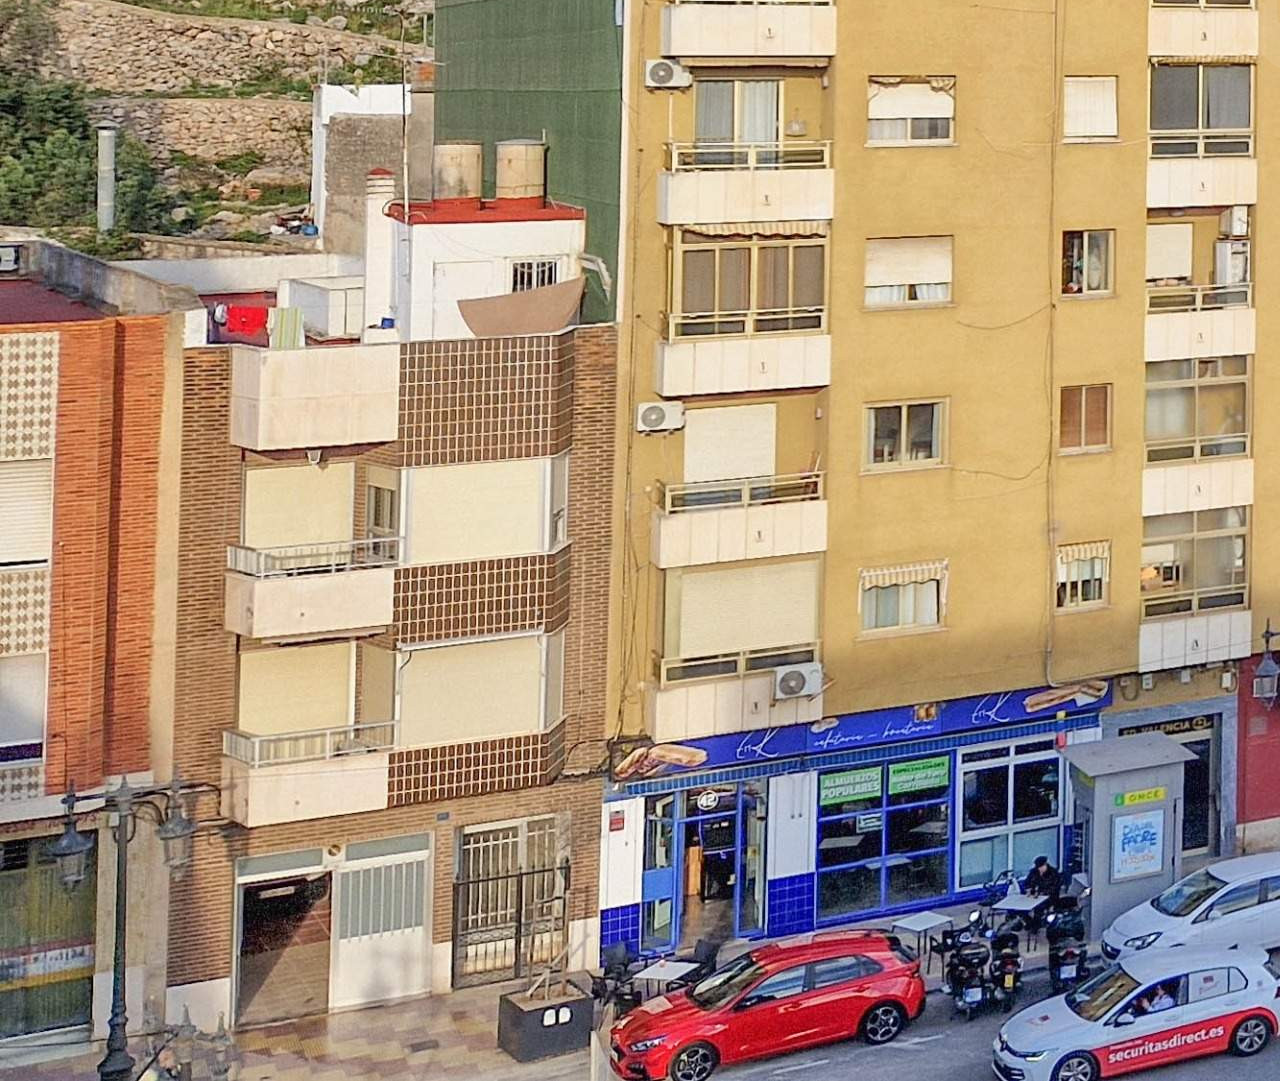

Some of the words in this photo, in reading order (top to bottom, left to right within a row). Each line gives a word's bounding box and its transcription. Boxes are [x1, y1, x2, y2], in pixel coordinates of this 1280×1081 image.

[823, 772, 880, 788] ALMUERZOS
[822, 781, 880, 800] POPULARES
[1128, 789, 1161, 803] ONCE
[700, 792, 717, 808] 42
[1108, 1025, 1225, 1064] securitasdirect.es
